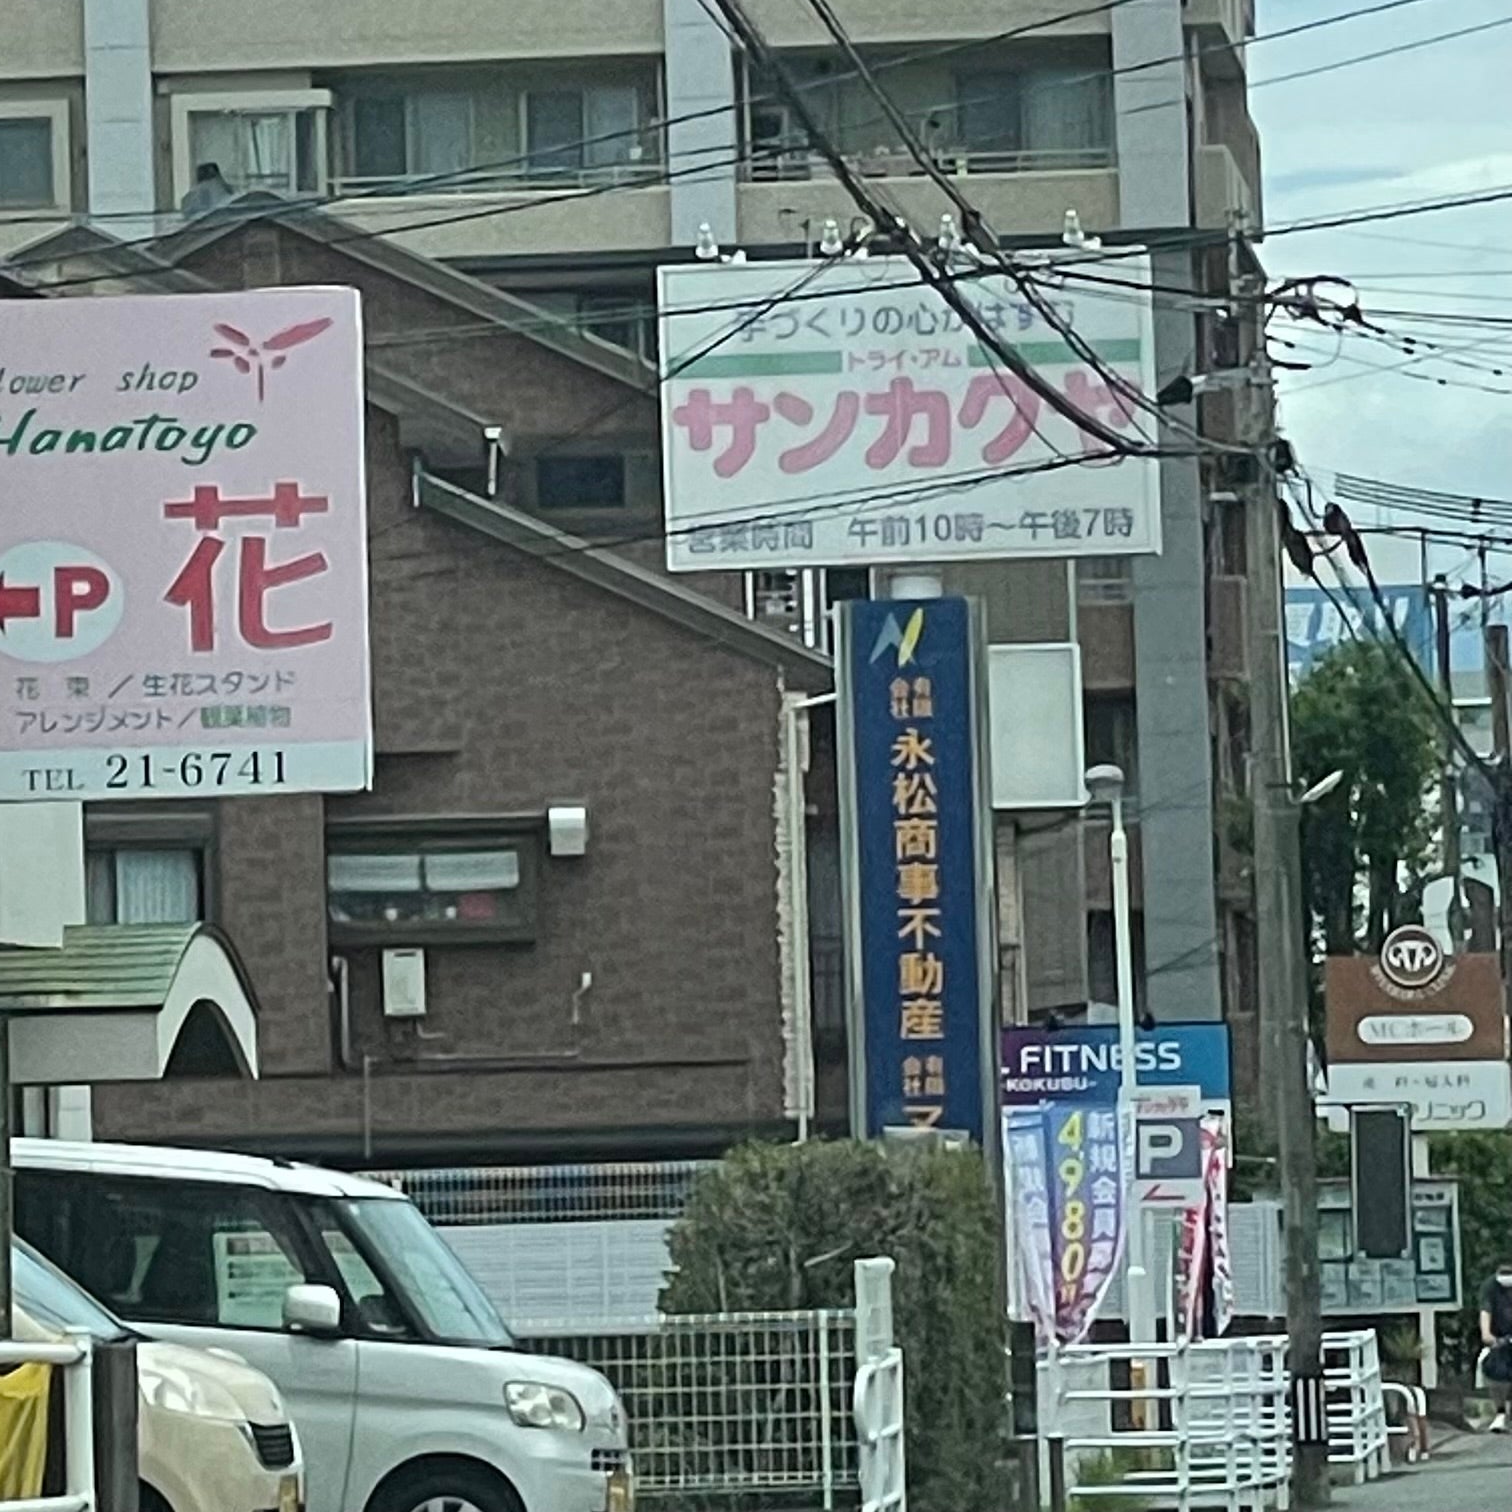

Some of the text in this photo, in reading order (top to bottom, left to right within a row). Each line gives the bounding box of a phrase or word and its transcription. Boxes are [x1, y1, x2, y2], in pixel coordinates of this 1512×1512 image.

[116, 362, 199, 394] shop
[847, 348, 962, 372] トライ・アム
[688, 521, 814, 554] 営業時間
[163, 483, 333, 653] 花
[54, 567, 111, 638] P
[24, 751, 287, 791] TEL 21-6741
[891, 727, 945, 1040] 永松商事不動産
[1140, 1124, 1183, 1175] P
